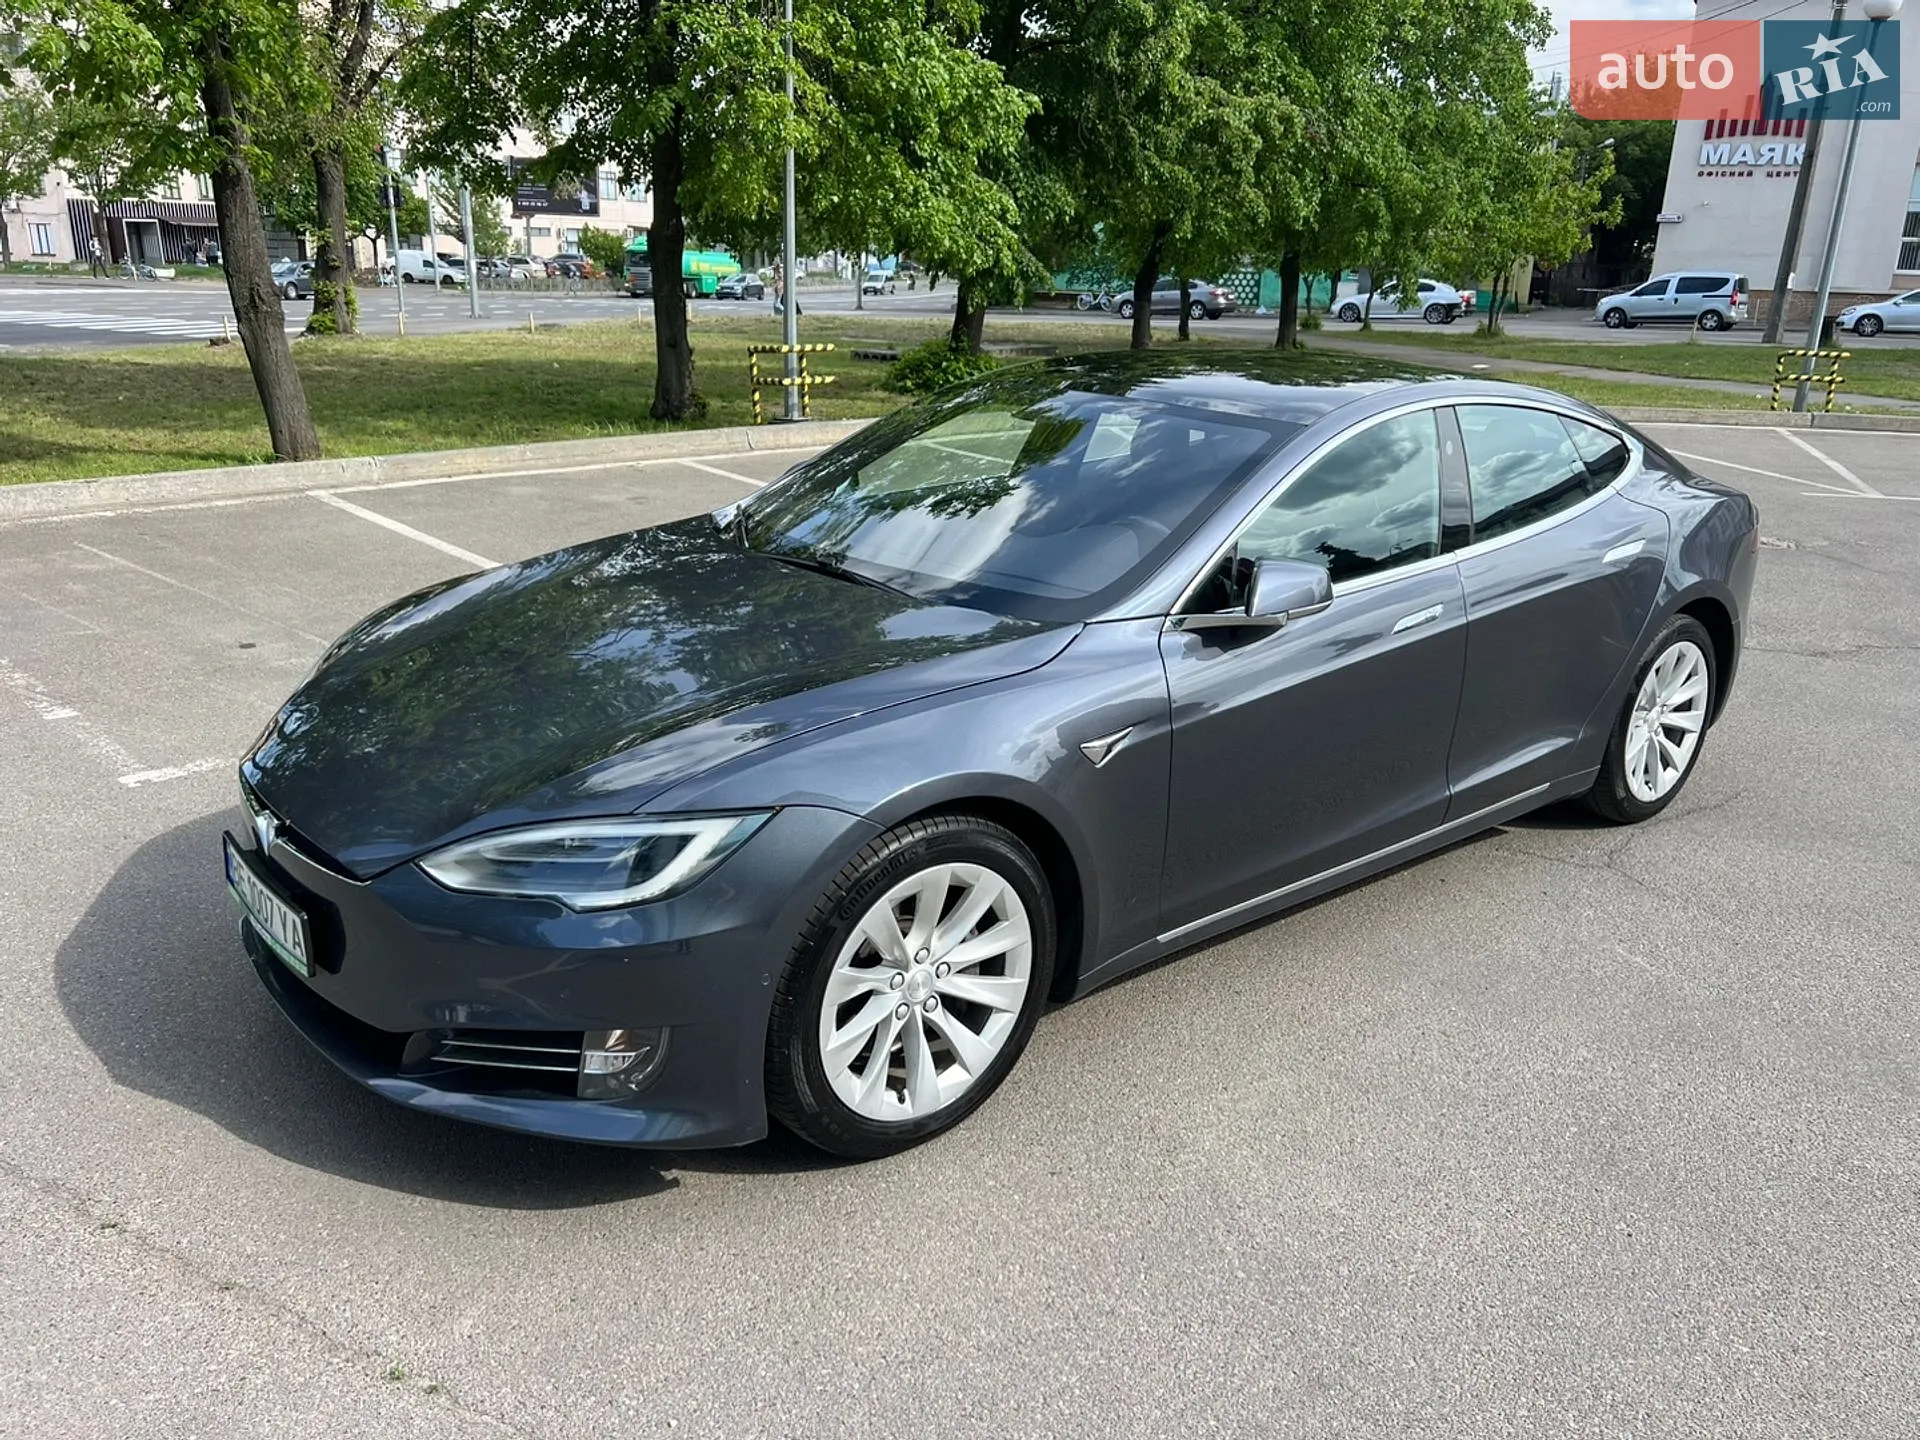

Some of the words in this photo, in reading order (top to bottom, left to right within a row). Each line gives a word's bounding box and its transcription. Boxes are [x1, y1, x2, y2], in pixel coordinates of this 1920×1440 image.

[1698, 142, 1807, 166] МАЯК
[1697, 170, 1754, 178] ОФІСНИЙ
[1766, 170, 1801, 178] ЦЕНТ
[275, 901, 305, 957] YA
